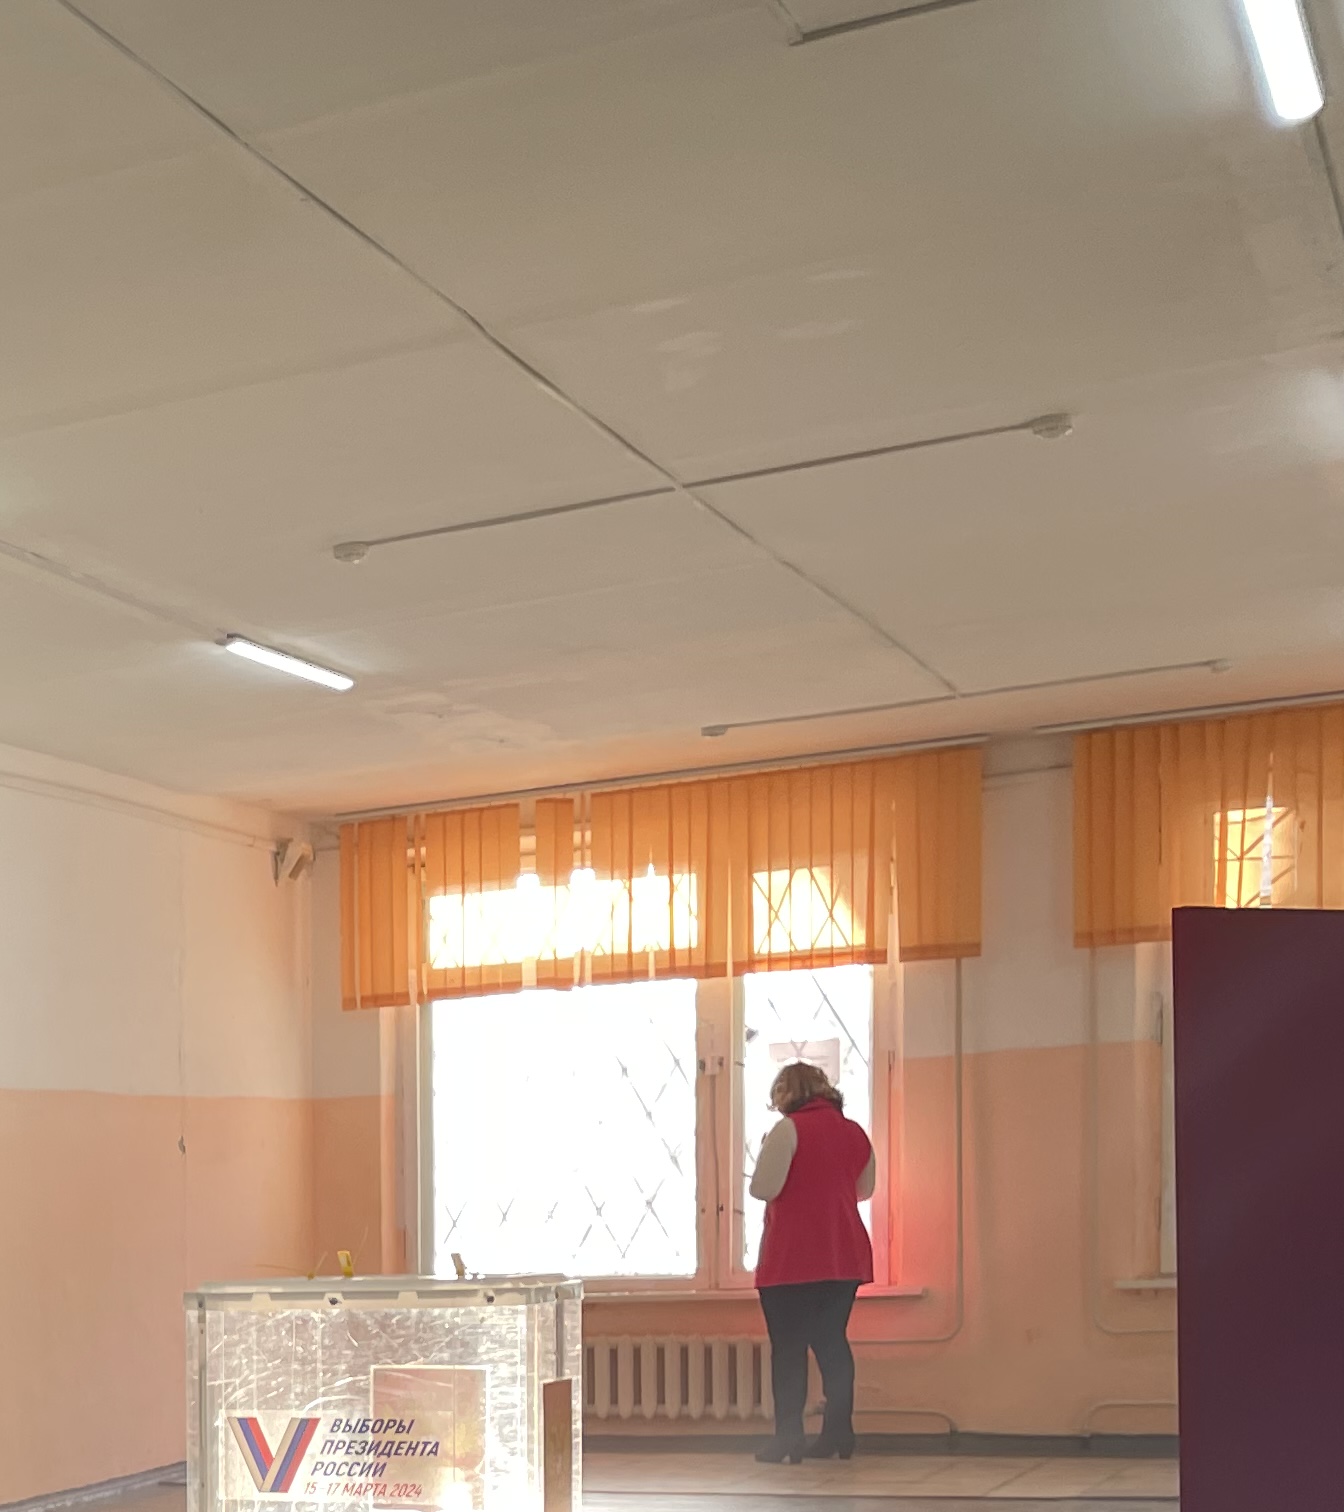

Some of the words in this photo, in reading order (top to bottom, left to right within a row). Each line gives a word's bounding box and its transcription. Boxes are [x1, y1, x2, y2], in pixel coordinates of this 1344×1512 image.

[330, 1417, 416, 1435] ВЫБОРЫ
[320, 1439, 441, 1458] ПРЕЗИДЕНТА
[311, 1461, 388, 1477] РОССИИ
[342, 1482, 387, 1497] МАРТА
[389, 1483, 423, 1498] 2024
